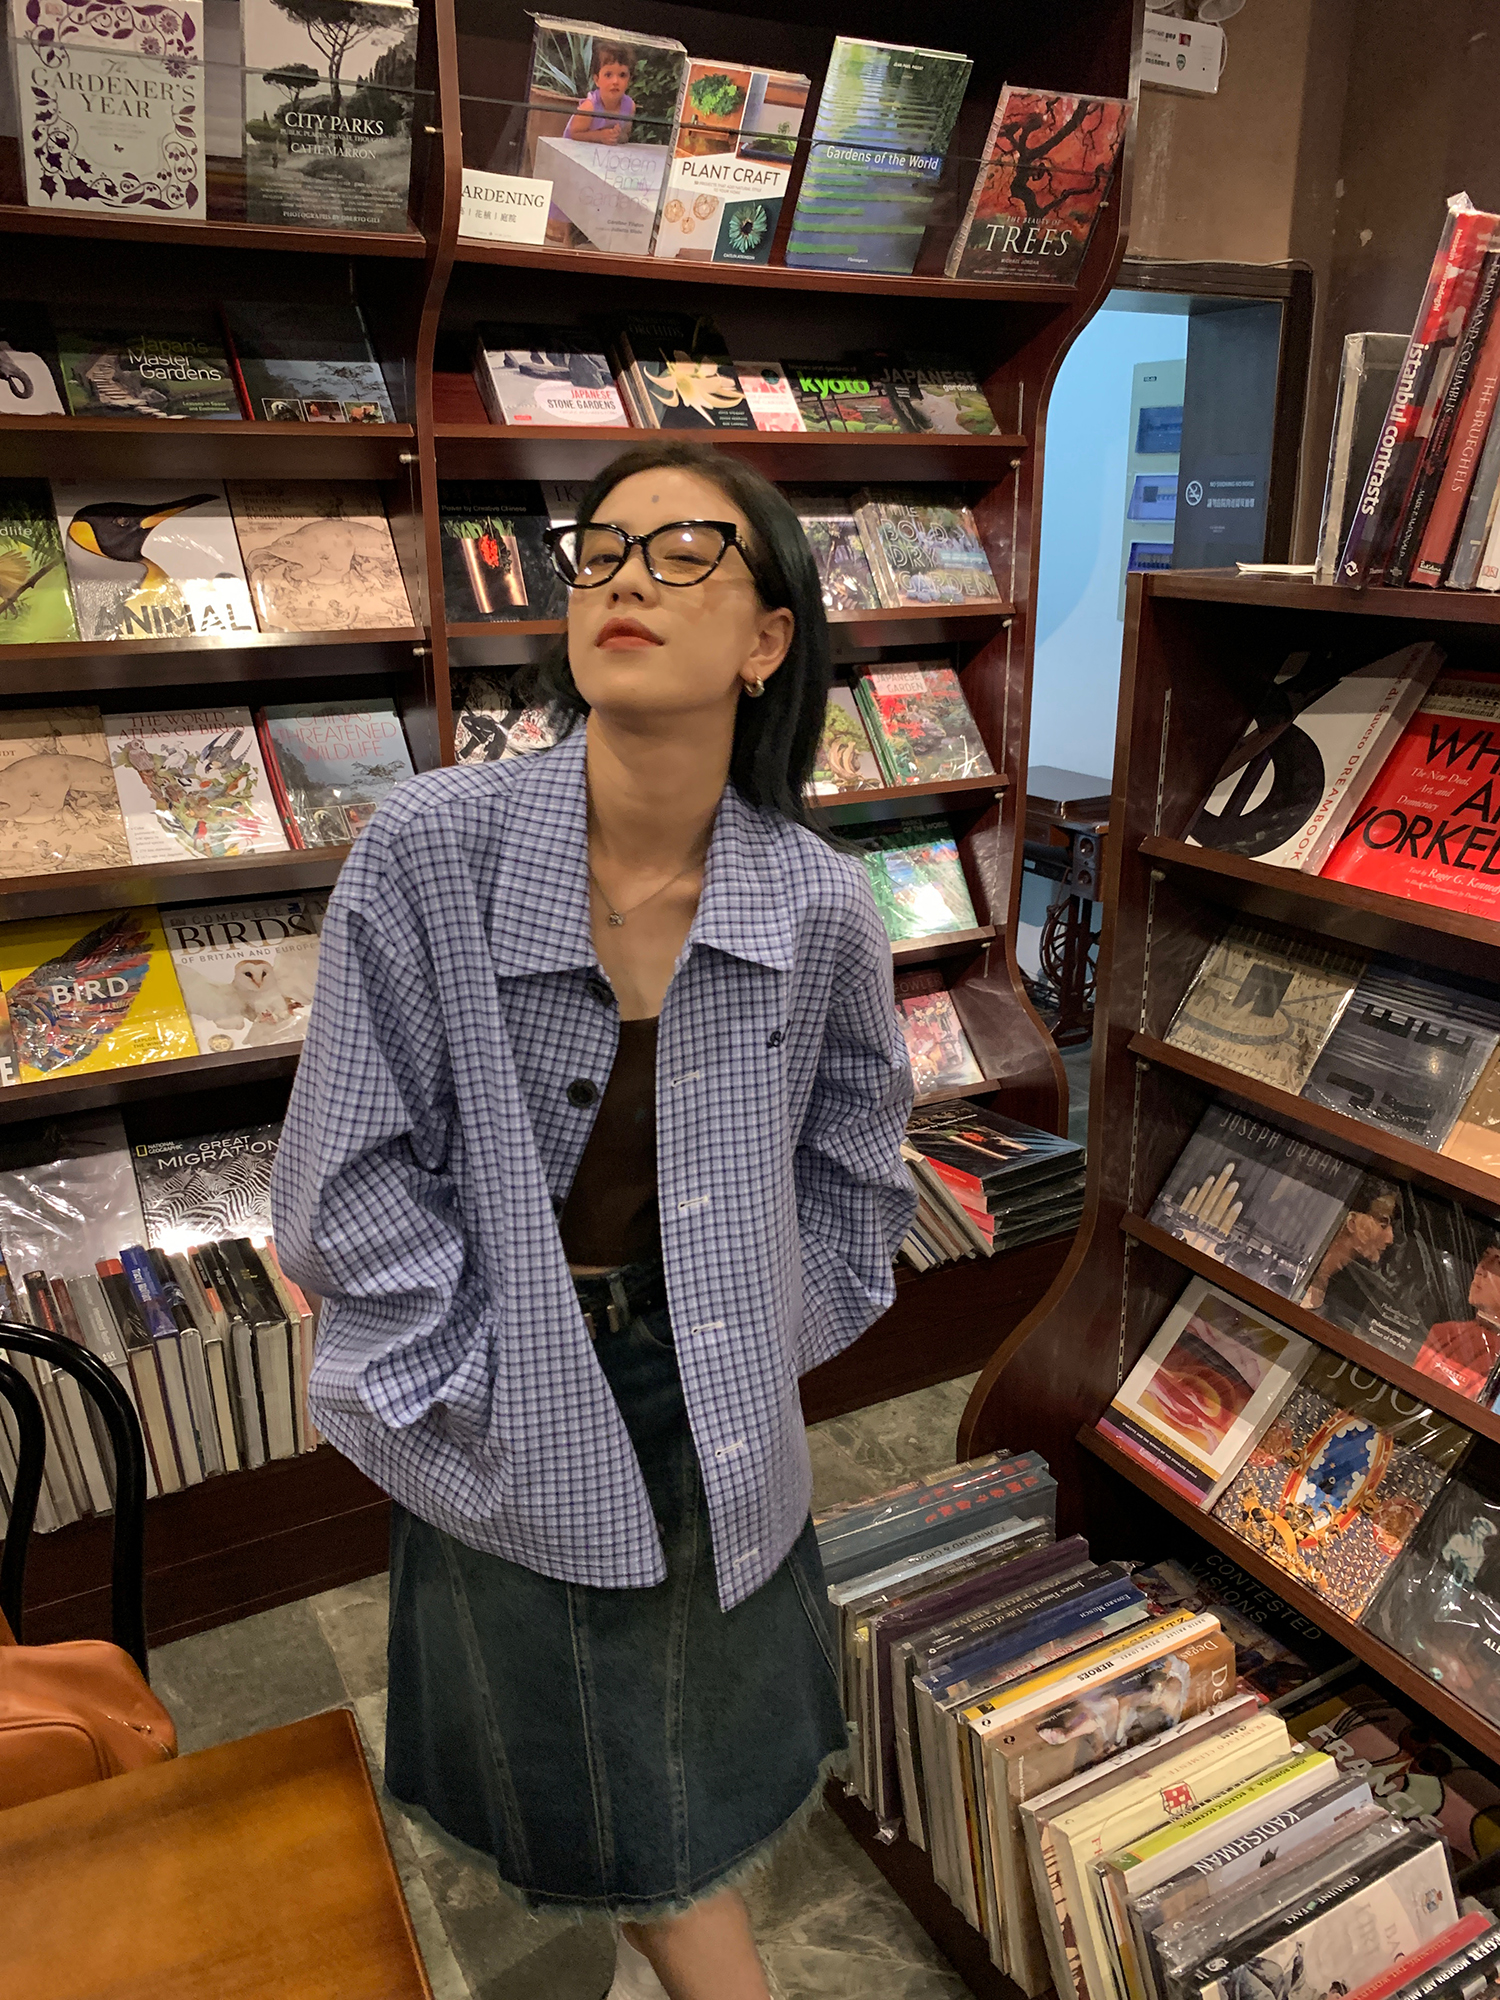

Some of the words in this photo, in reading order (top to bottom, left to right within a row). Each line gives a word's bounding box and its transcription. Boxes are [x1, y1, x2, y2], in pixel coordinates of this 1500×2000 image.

[31, 66, 195, 102] GARDENER'S
[79, 92, 151, 119] YEAR
[285, 112, 327, 130] CITY
[330, 116, 384, 135] PARKS
[291, 143, 324, 155] CATIE
[327, 147, 376, 159] MARRON
[592, 148, 657, 174] Modern
[826, 145, 872, 163] Gardens
[874, 152, 887, 164] of
[888, 153, 906, 167] the
[908, 155, 940, 171] World
[604, 169, 655, 195] Family
[682, 161, 730, 181] PLANT
[733, 168, 780, 186] CRAFT
[462, 185, 544, 208] ARDENING
[579, 186, 649, 209] Gardens
[283, 211, 331, 220] PHOTOGRAPHS
[1023, 217, 1049, 225] BEAUTY
[985, 223, 1073, 257] TREES
[139, 335, 209, 355] Japan's
[128, 348, 194, 368] Master
[139, 361, 222, 382] Gardens
[880, 367, 977, 385] JAPANESE
[1389, 341, 1430, 424] istanbul
[1444, 341, 1473, 413] COLUMBUS
[571, 389, 611, 400] JAPANESE
[797, 370, 871, 398] kyoto
[943, 384, 977, 392] gardens
[1482, 375, 1499, 409] THE
[547, 399, 576, 410] STONE
[577, 400, 616, 411] GARDENS
[1450, 408, 1488, 494] BRUEGHELS
[1361, 424, 1399, 516] contrasts
[0, 526, 33, 537] dlife
[880, 517, 948, 544] BOLD
[886, 544, 937, 568] DRY
[898, 570, 997, 596] GARDEN
[95, 603, 253, 637] ANIMAL
[875, 671, 922, 682] JAPANESE
[886, 682, 925, 693] GARDEN
[1385, 687, 1399, 701] di
[119, 726, 170, 740] ATLAS
[173, 724, 196, 736] OF
[199, 721, 245, 735] BIRDS
[131, 715, 161, 728] THE
[164, 711, 225, 725] WORLD
[1356, 703, 1391, 750] Suvero
[276, 722, 398, 743] THREATENED
[302, 740, 386, 763] WILDLIFE
[1411, 767, 1429, 778] The
[1428, 770, 1447, 782] New
[1448, 773, 1470, 786] Deal,
[1415, 783, 1434, 794] Art,
[1435, 788, 1456, 798] and
[1289, 754, 1361, 861] DREAMBOOK
[1396, 794, 1440, 812] Democracy
[1428, 867, 1453, 882] Roger
[1453, 875, 1465, 885] G.
[1466, 878, 1500, 896] Kennedy
[191, 905, 286, 926] COMPLETE
[171, 914, 313, 956] BIRDS
[181, 956, 196, 965] OF
[199, 951, 245, 963] BRITAIN
[249, 947, 271, 957] AND
[274, 941, 316, 955] EUROPE
[51, 977, 129, 1005] BIRD
[894, 976, 944, 996] FOWLER
[148, 1141, 176, 1150] NATIONAL
[148, 1144, 184, 1156] GEOGRAPHIC
[157, 1138, 281, 1170] MIGRATION
[199, 1135, 251, 1151] GREAT
[1219, 1111, 1281, 1149] JOSEPH
[1284, 1139, 1345, 1178] URBAN
[1326, 1360, 1438, 1432] JUJOL
[1038, 1588, 1061, 1607] Tissot
[1059, 1577, 1085, 1598] James
[1005, 1605, 1022, 1620] Life
[1021, 1598, 1039, 1614] The
[1078, 1601, 1105, 1622] MUNCH
[969, 1615, 997, 1637] Christ
[995, 1613, 1006, 1624] of
[1069, 1626, 1105, 1652] Ahlam
[1043, 1641, 1073, 1664] Shibli
[1177, 1636, 1217, 1666] Degas
[1075, 1657, 1114, 1684] HEROES
[1215, 1718, 1266, 1753] FRANCESCO
[1167, 1746, 1215, 1778] CLEMENTE
[1288, 1756, 1307, 1770] JOHN
[1256, 1766, 1289, 1788] ROMBOLA
[1307, 1724, 1445, 1838] FRANCIS
[1215, 1789, 1247, 1810] ECLECTIC
[1178, 1805, 1216, 1830] ECCENTRIC
[1192, 1809, 1302, 1875] KADISHMAN
[1314, 1872, 1361, 1905] GENUINE
[1280, 1905, 1309, 1927] FAKE
[1433, 1955, 1472, 1985] MODERN
[1418, 1978, 1438, 1994] ART
